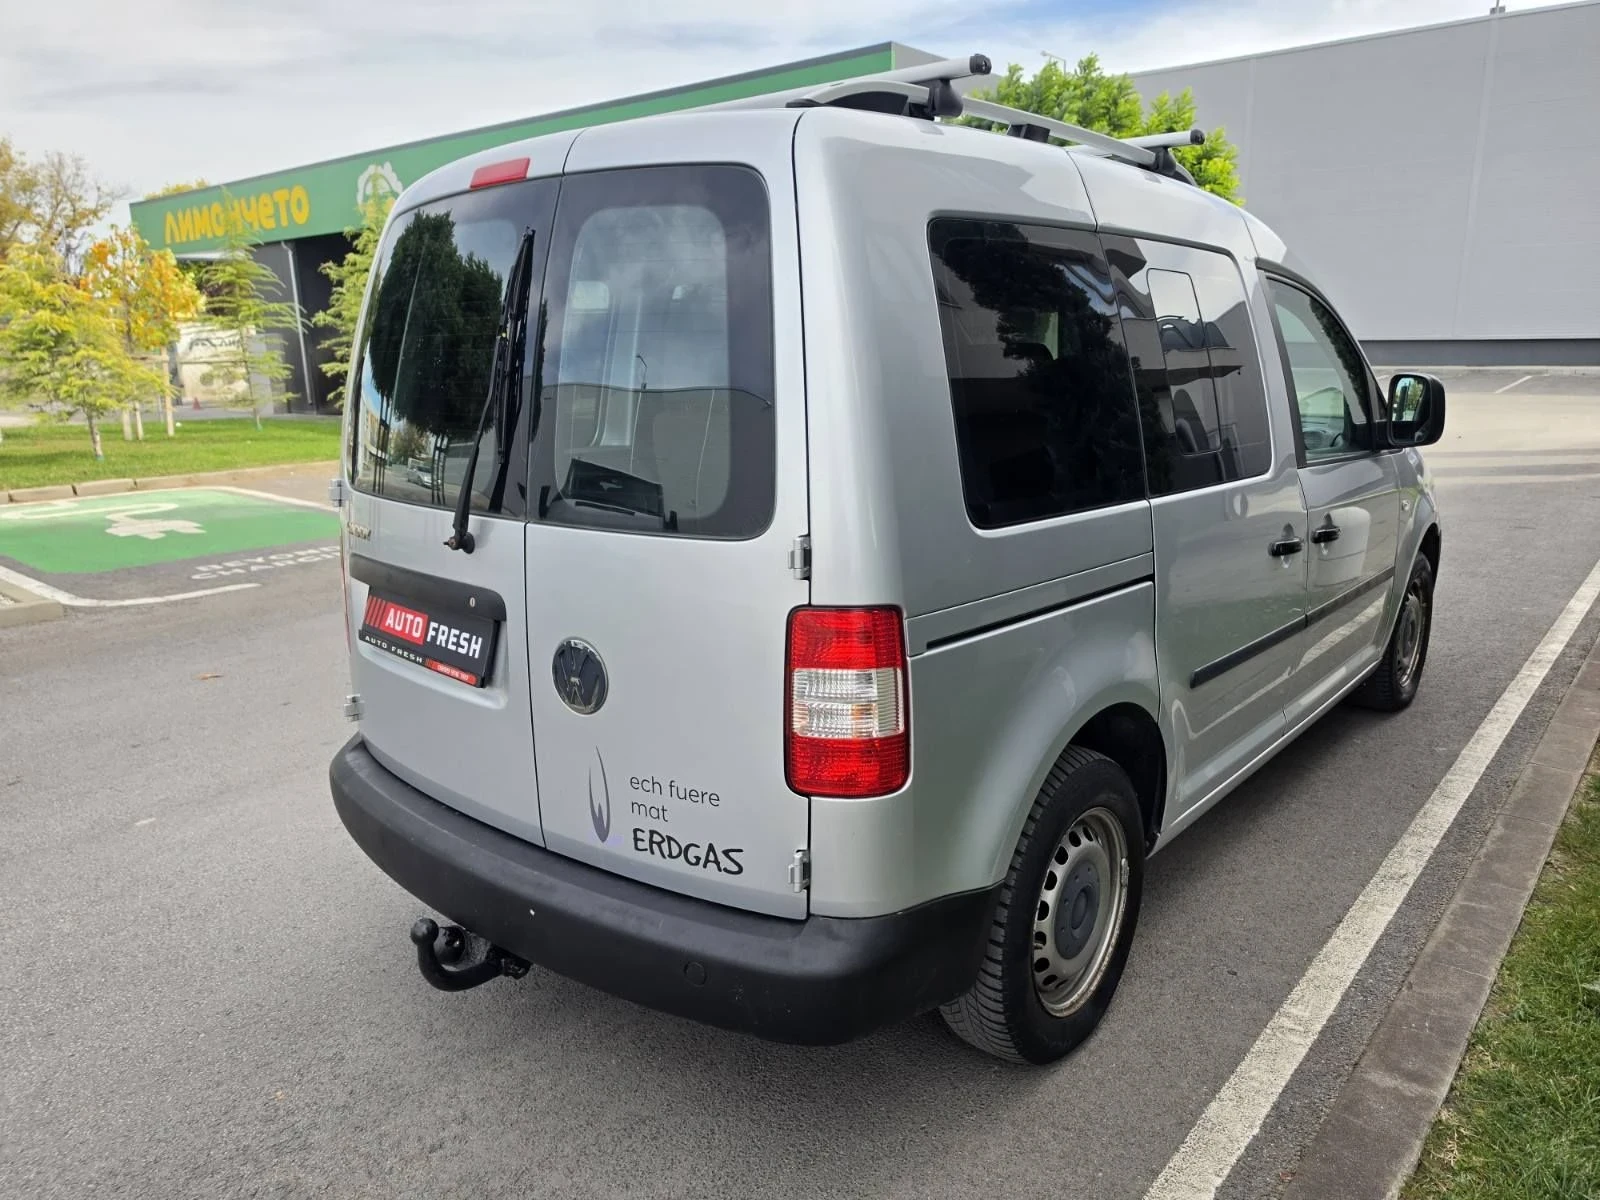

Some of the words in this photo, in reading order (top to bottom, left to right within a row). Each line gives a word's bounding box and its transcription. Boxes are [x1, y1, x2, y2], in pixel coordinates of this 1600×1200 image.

[385, 607, 423, 638] AUTO
[426, 621, 482, 659] FRESH
[365, 635, 388, 649] AUTO
[391, 646, 423, 663] FRESH
[630, 776, 662, 795] ech
[669, 780, 720, 807] fuere
[631, 801, 668, 822] mat
[632, 828, 744, 875] ERDGAS
